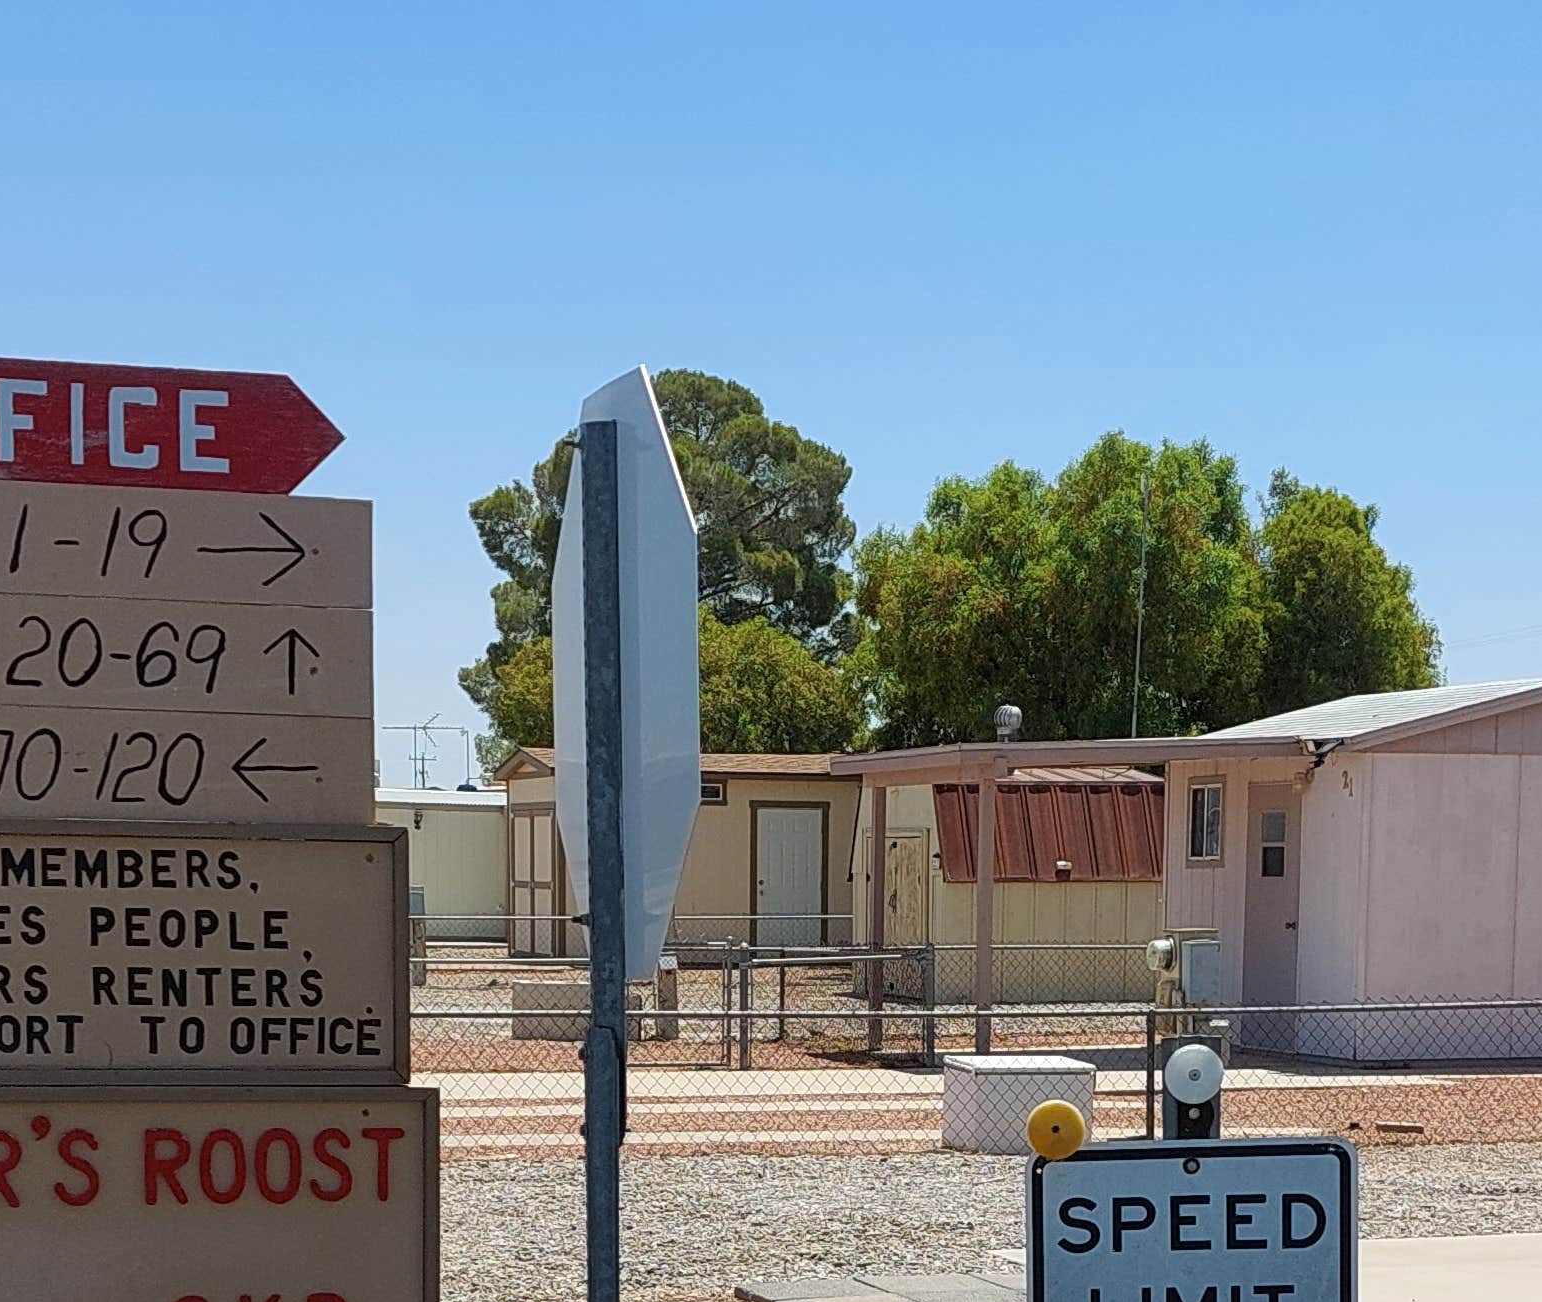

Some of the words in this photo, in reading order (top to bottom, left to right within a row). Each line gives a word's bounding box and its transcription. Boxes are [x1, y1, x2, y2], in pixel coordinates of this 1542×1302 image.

[9, 503, 168, 579] 1-19
[5, 615, 227, 695] 20-69
[1342, 770, 1353, 797] 21
[139, 1015, 206, 1055] TO
[229, 1016, 383, 1057] OFFICE
[144, 1128, 403, 1205] ROOST
[1057, 1193, 1327, 1254] SPEED
